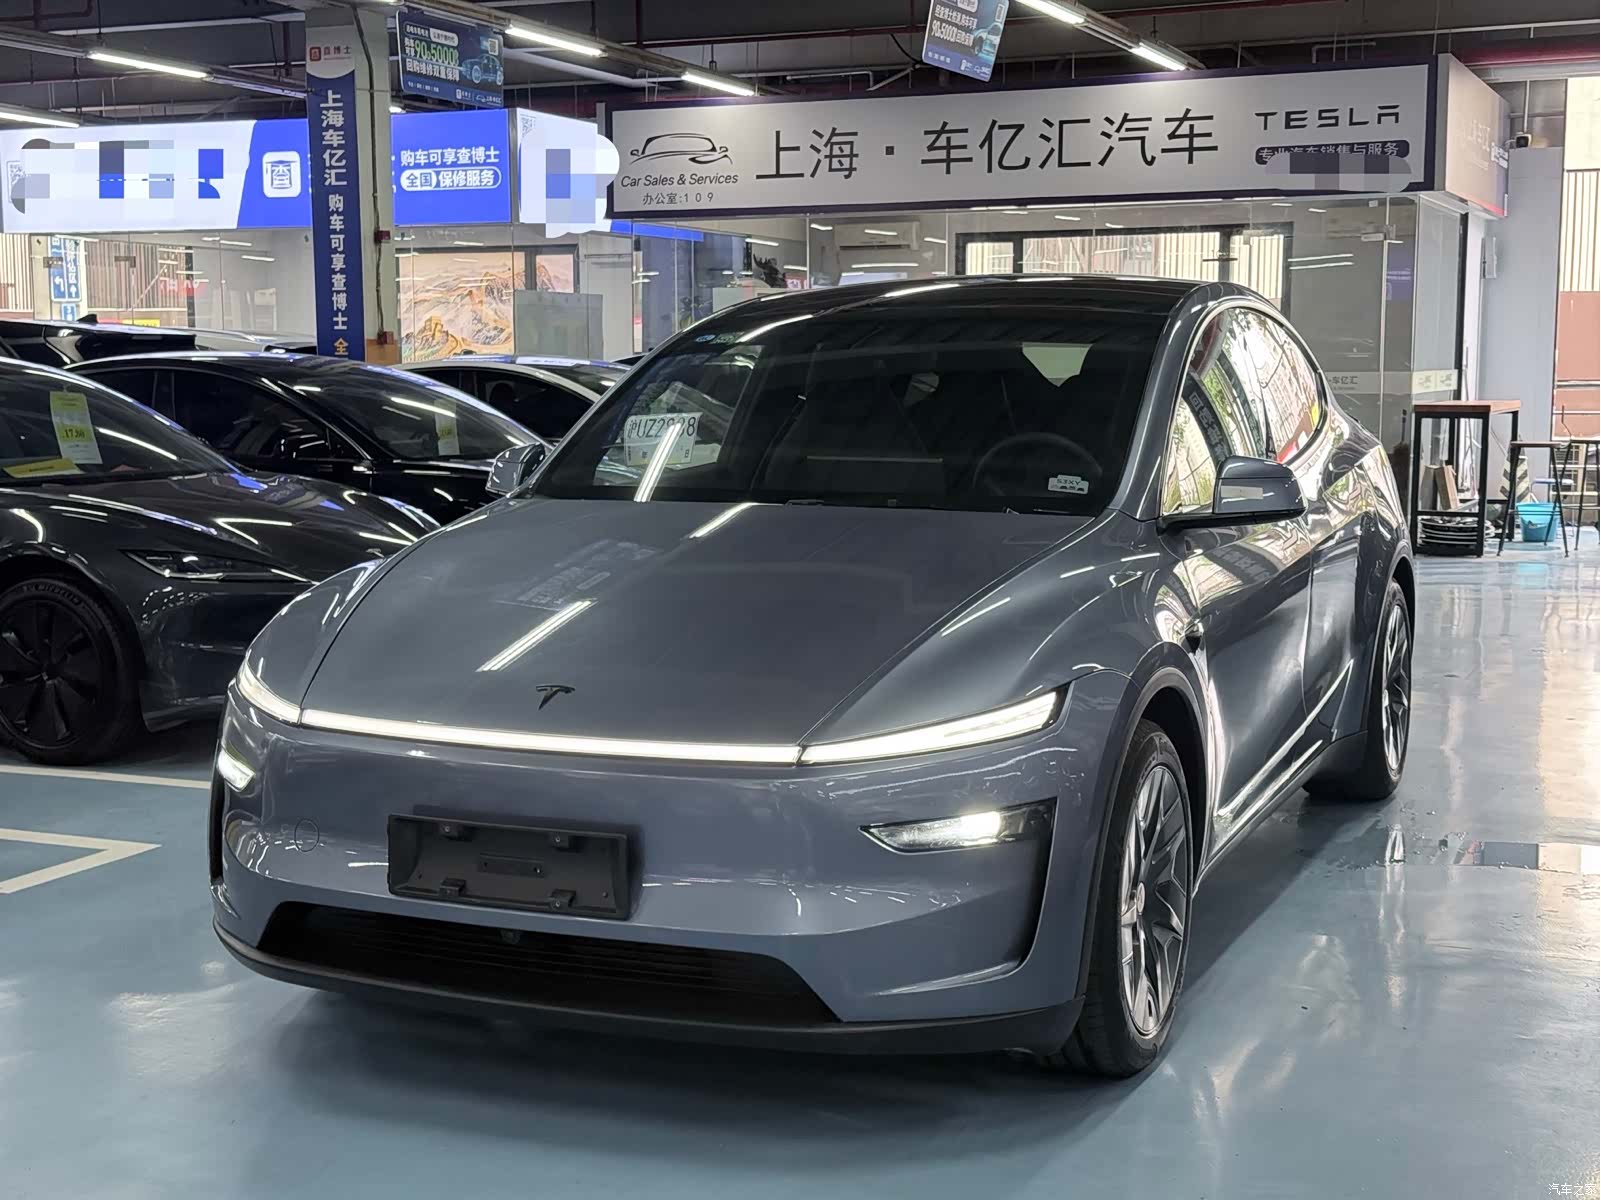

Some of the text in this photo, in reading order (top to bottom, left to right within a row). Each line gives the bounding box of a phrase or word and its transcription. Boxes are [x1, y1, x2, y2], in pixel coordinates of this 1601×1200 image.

[1254, 104, 1400, 131] TESLA
[319, 89, 348, 186] 上海车亿汇
[400, 145, 500, 167] 购车可享查博士
[406, 170, 495, 188] 全国 保修服务
[620, 172, 739, 188] Car Sales & Services
[328, 193, 348, 331] 购车可享查博士
